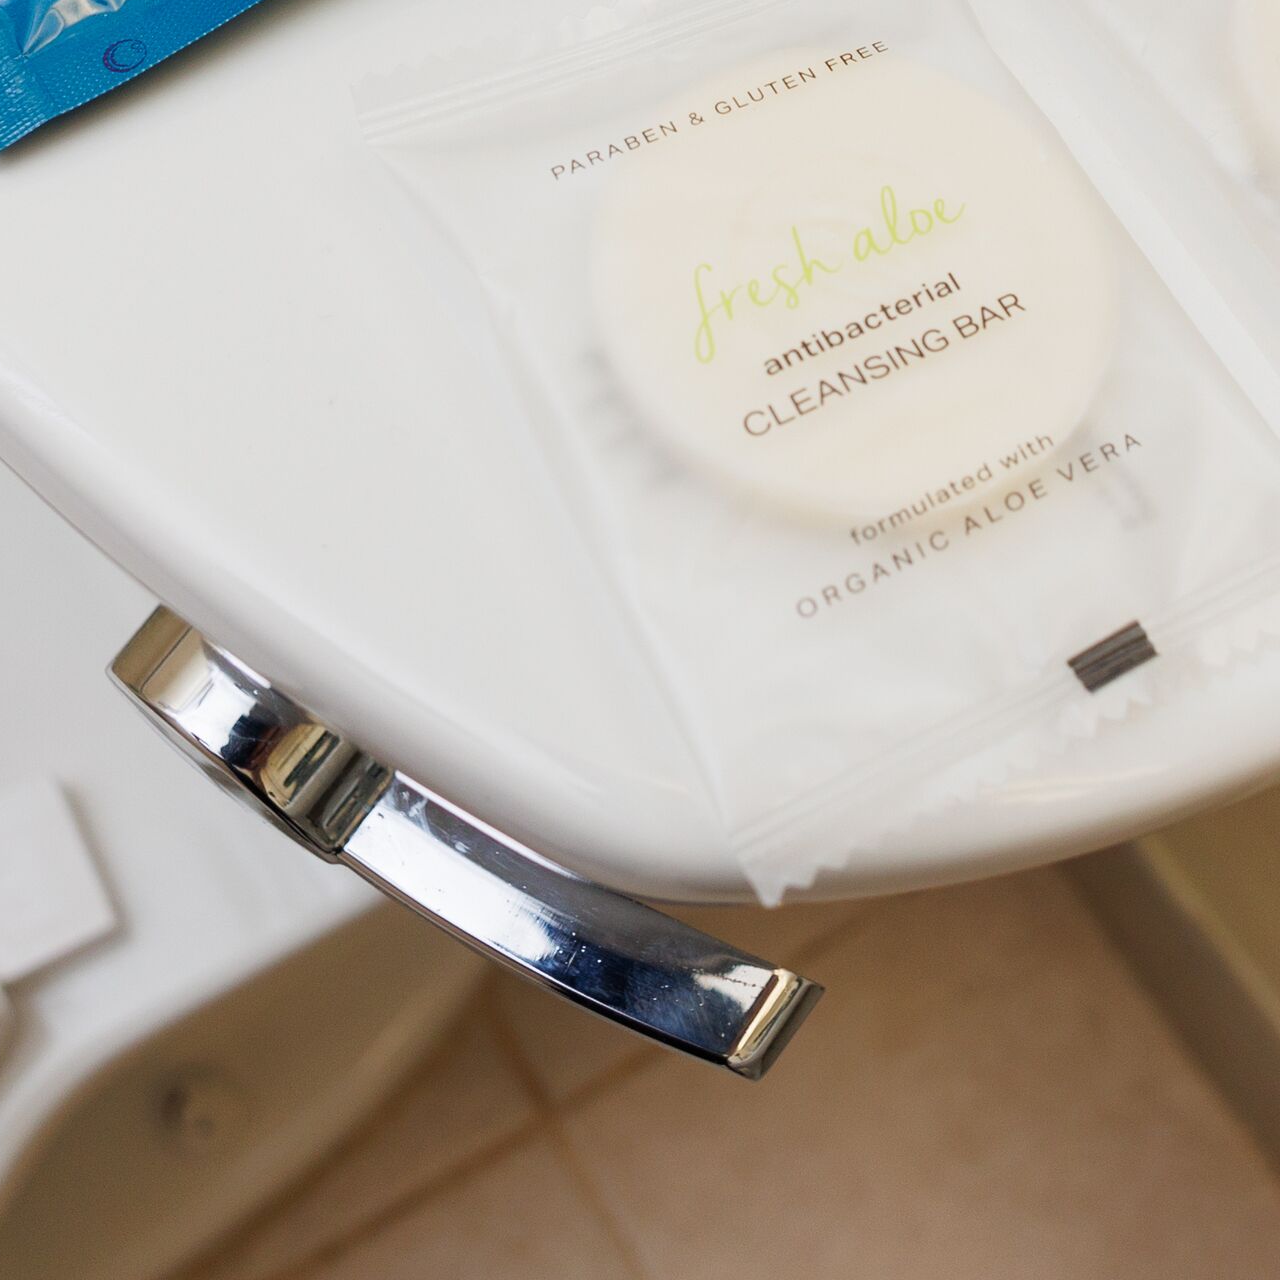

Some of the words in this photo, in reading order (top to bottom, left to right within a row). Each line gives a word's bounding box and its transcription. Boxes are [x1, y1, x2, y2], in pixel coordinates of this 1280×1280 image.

[551, 120, 679, 180] PARABEN
[688, 112, 705, 125] &
[714, 67, 817, 115] GLUTEN
[825, 39, 888, 71] FREE
[692, 226, 842, 363] fresh
[852, 186, 966, 263] aloe
[763, 273, 961, 376] antibacterial
[742, 328, 950, 436] CLEANSING
[952, 292, 1026, 341] BAR
[796, 530, 950, 619] ORGANIC
[963, 478, 1047, 535] ALOE
[1057, 432, 1142, 484] VERA
[849, 465, 993, 547] formulated
[999, 432, 1055, 471] with
